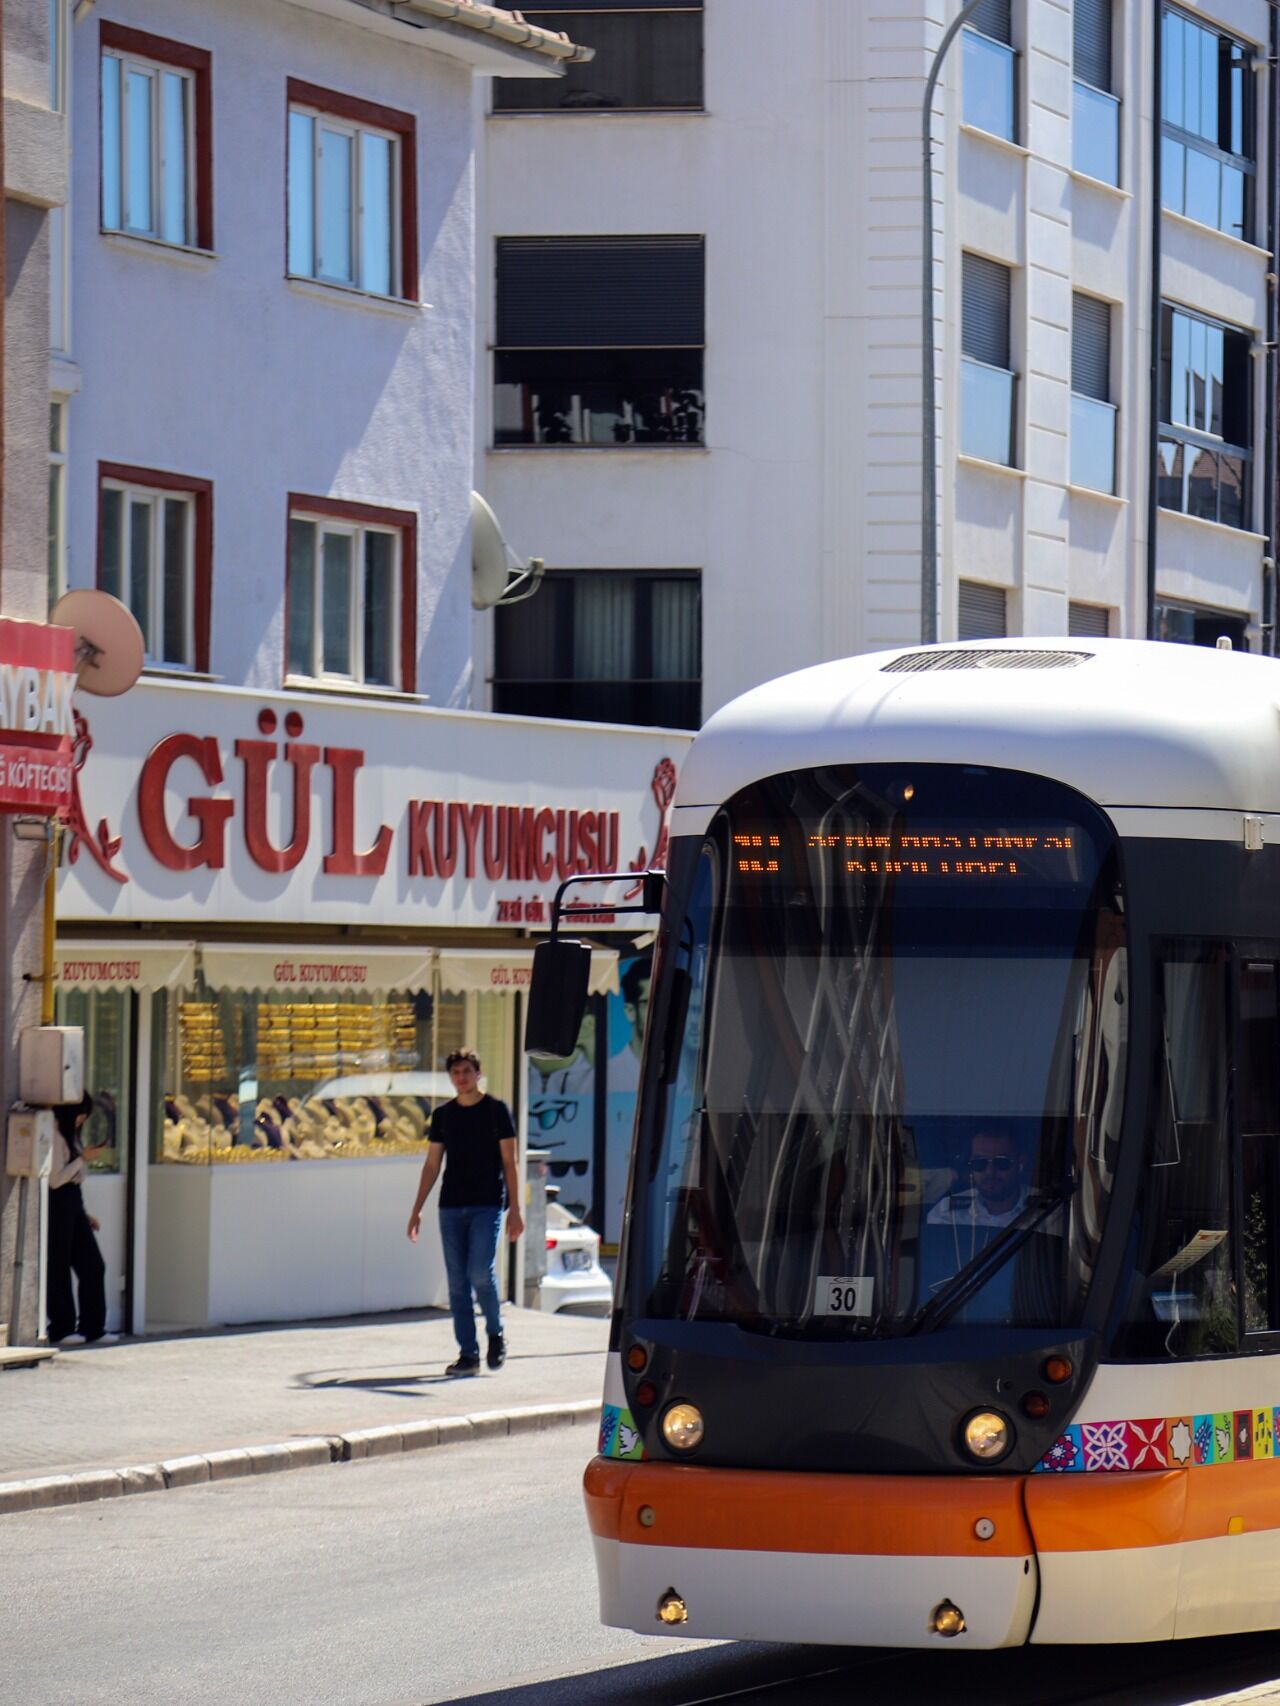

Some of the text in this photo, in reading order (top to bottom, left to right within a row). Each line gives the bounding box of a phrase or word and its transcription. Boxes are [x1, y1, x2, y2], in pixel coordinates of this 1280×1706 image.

[138, 708, 393, 876] GÜL
[408, 799, 619, 886] KUYUMCUSU
[830, 1287, 856, 1312] 30
